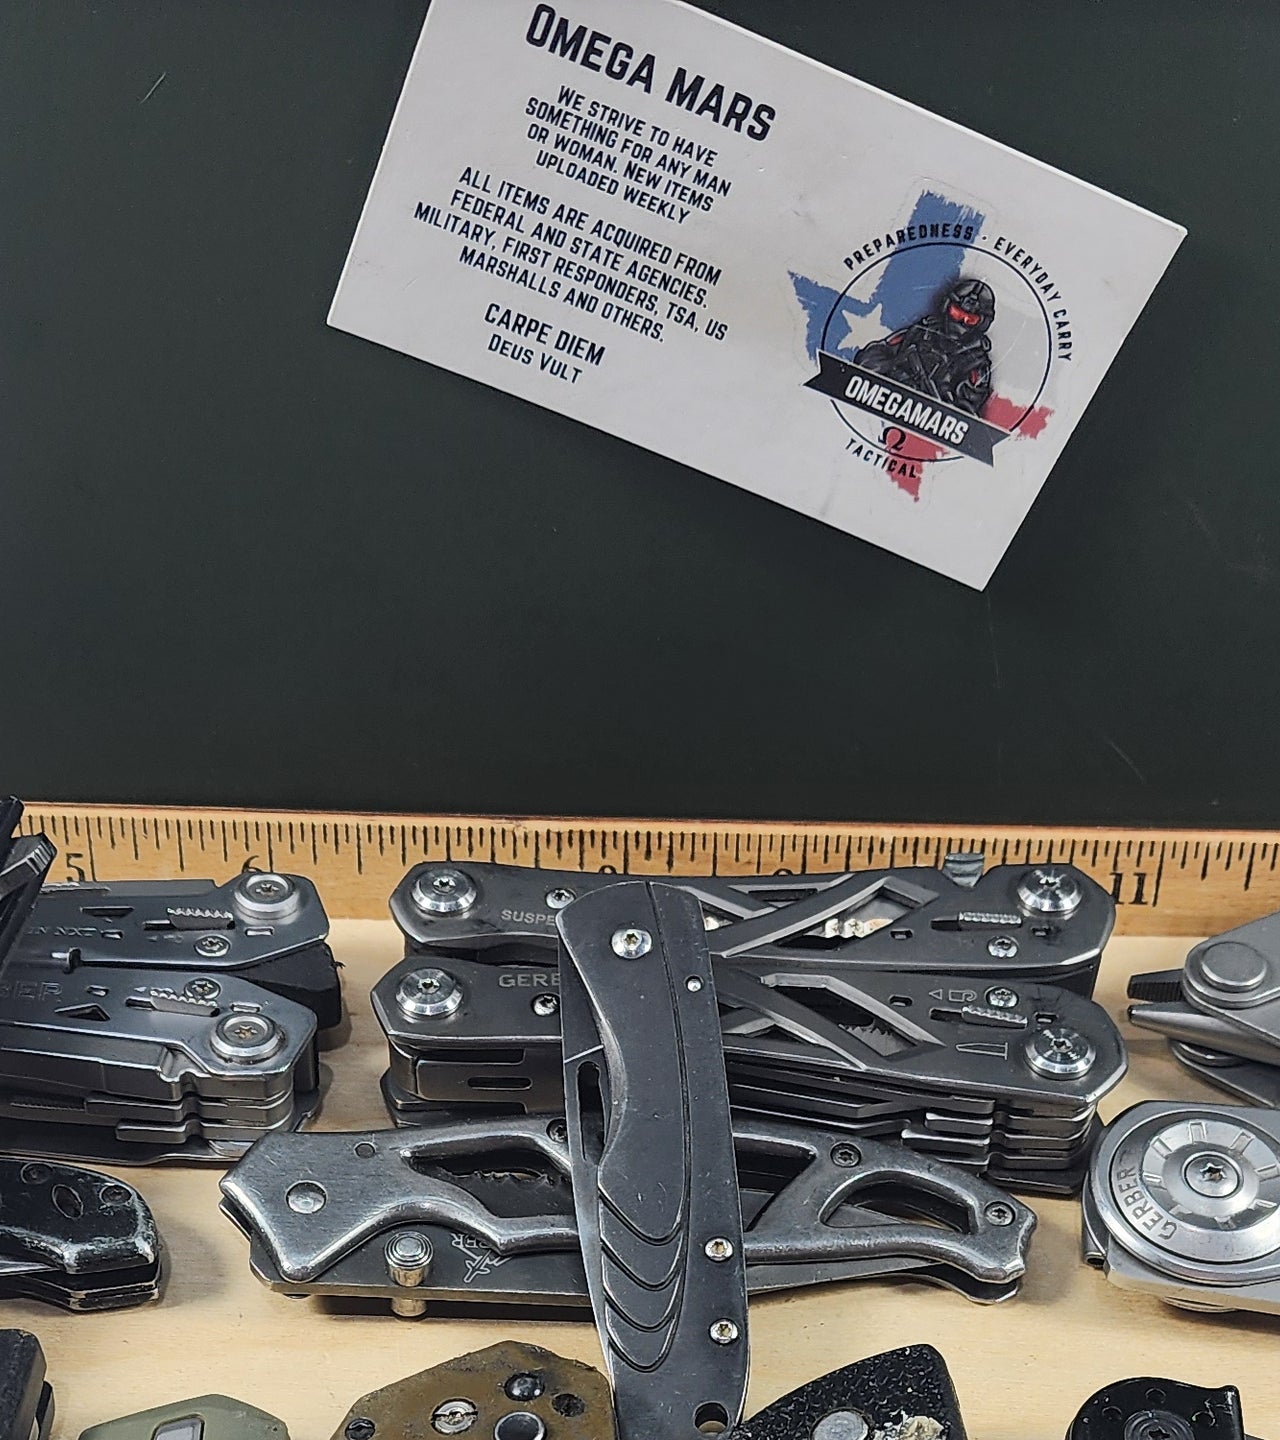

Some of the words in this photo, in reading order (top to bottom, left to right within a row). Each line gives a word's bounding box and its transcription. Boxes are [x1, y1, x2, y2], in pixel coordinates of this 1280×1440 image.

[525, 3, 656, 94] OMEGA
[664, 66, 776, 142] MARS
[525, 96, 619, 149] SOMETHING
[619, 137, 654, 164] FOR
[654, 154, 693, 179] ANY
[692, 168, 732, 197] MAN
[527, 123, 550, 145] OR
[553, 133, 618, 174] WOMAN.
[622, 160, 663, 190] NEW
[663, 179, 714, 212] ITEMS
[557, 85, 586, 112] WE
[587, 100, 647, 137] STRIVE
[649, 125, 670, 147] TO
[671, 135, 718, 168] HAVE
[458, 166, 491, 194] ALL
[497, 180, 551, 215] ITEMS
[551, 203, 590, 231] ARE
[589, 219, 673, 265] ACQUIRED
[673, 252, 722, 287] FROM
[535, 149, 620, 196] UPLOADED
[623, 184, 691, 224] WEEKLY
[413, 201, 497, 251] MILITARY,
[502, 236, 552, 268] FIRST
[552, 256, 659, 316] RESPONDERS,
[666, 301, 699, 333] TSA,
[704, 318, 728, 341] US
[450, 188, 525, 234] FEDERAL
[530, 222, 568, 249] AND
[569, 236, 625, 272] STATE
[624, 260, 707, 309] AGENCIES.
[459, 245, 562, 299] MARSHALLS
[562, 287, 600, 314] AND
[600, 302, 664, 343] OTHERS.
[484, 302, 553, 345] CARPE
[554, 329, 606, 366] DIEM
[842, 223, 974, 271] PREPAREDNESS
[993, 236, 1062, 304] EVERYDAY
[1052, 308, 1073, 362] CARRY
[487, 333, 534, 365] DEUS
[539, 352, 583, 384] VULT
[843, 374, 970, 446] OMEGAMARS
[844, 438, 920, 478] TACTICAL
[65, 852, 86, 882] 5
[1109, 872, 1149, 905] 11
[1116, 1165, 1179, 1241] GERBER
